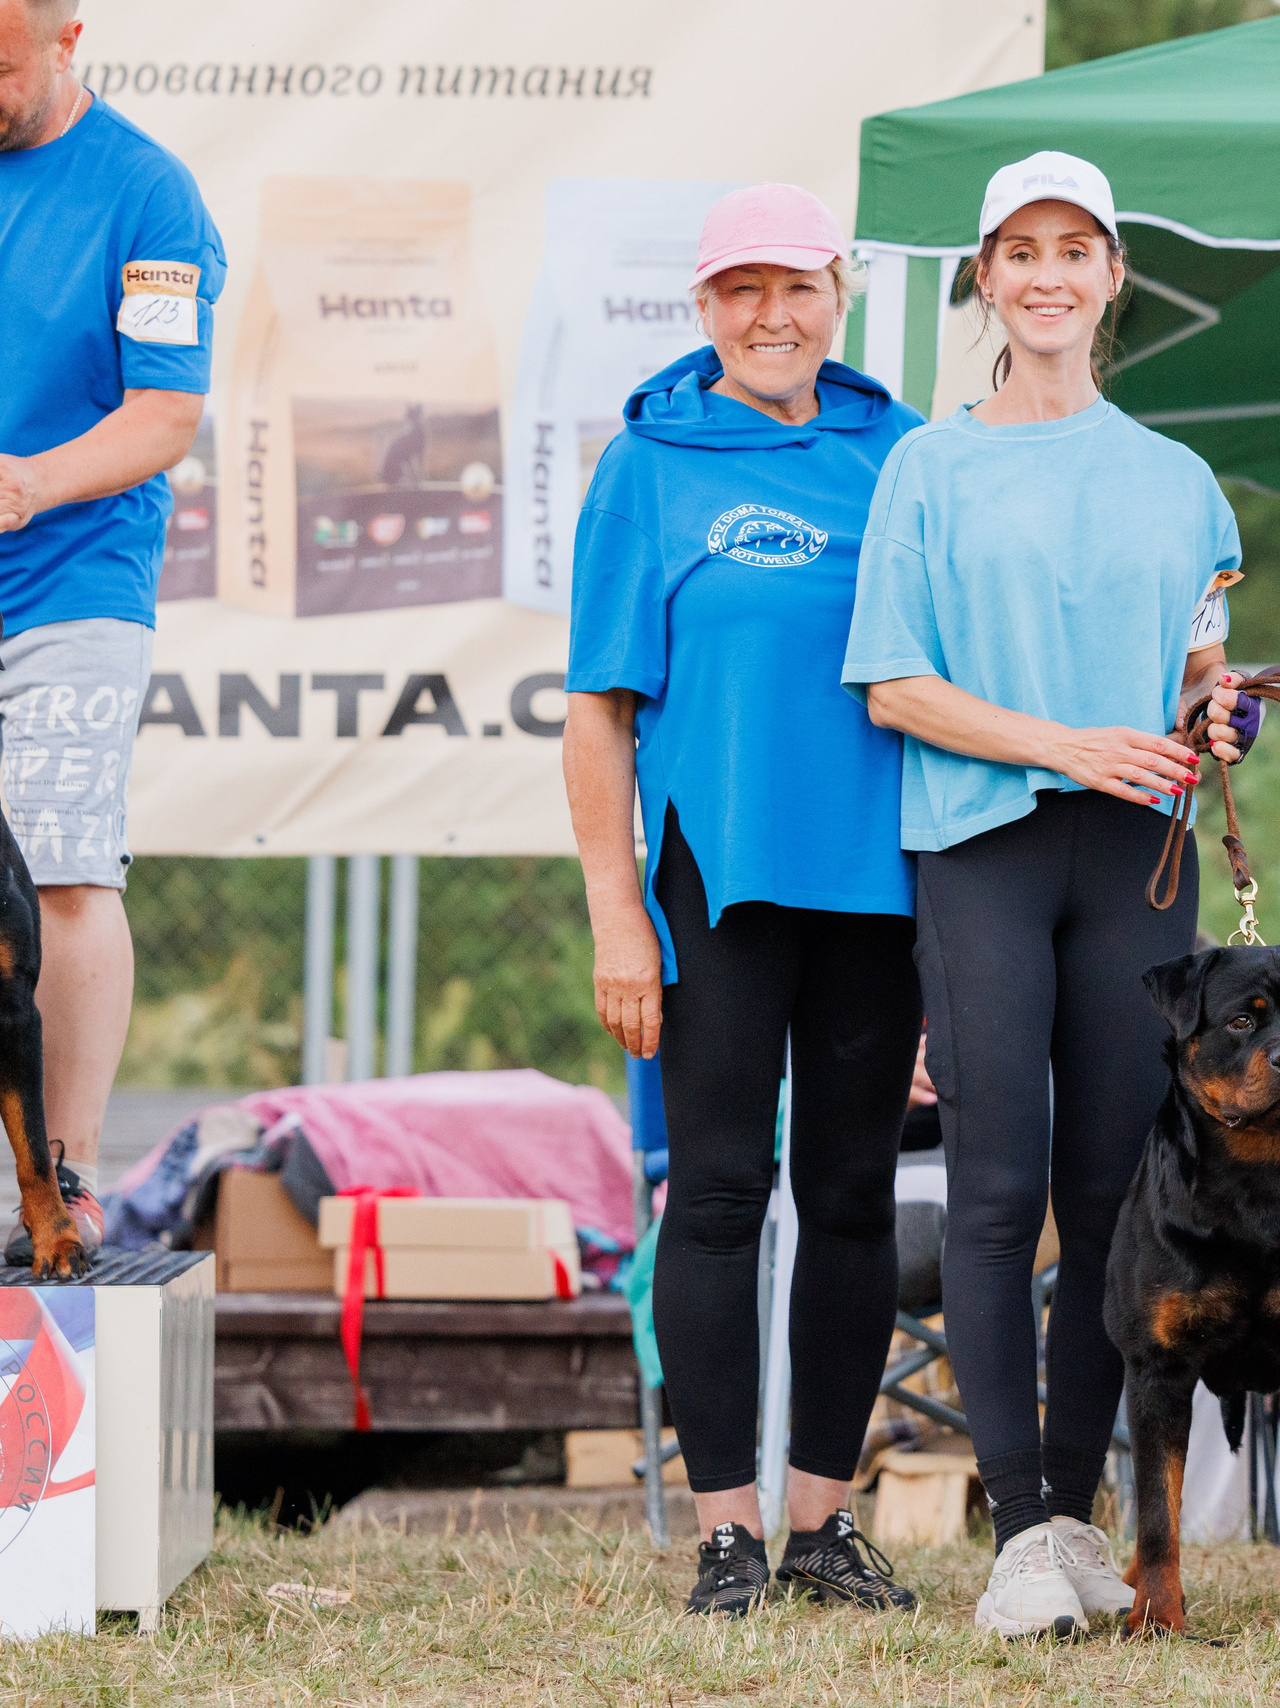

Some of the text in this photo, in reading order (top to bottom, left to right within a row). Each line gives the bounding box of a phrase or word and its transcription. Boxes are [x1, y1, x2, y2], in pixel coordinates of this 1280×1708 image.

[399, 63, 653, 97] питания
[1022, 172, 1080, 191] FILA
[127, 269, 194, 285] Hanta
[319, 294, 452, 319] Hanta
[603, 296, 697, 322] Han
[249, 419, 268, 590] Hanta
[534, 422, 554, 588] Hanta
[721, 506, 757, 523] DOMA
[761, 506, 803, 527] TORRA
[728, 547, 809, 565] ROTTWEILER
[1, 1359, 48, 1513] РОССИИ
